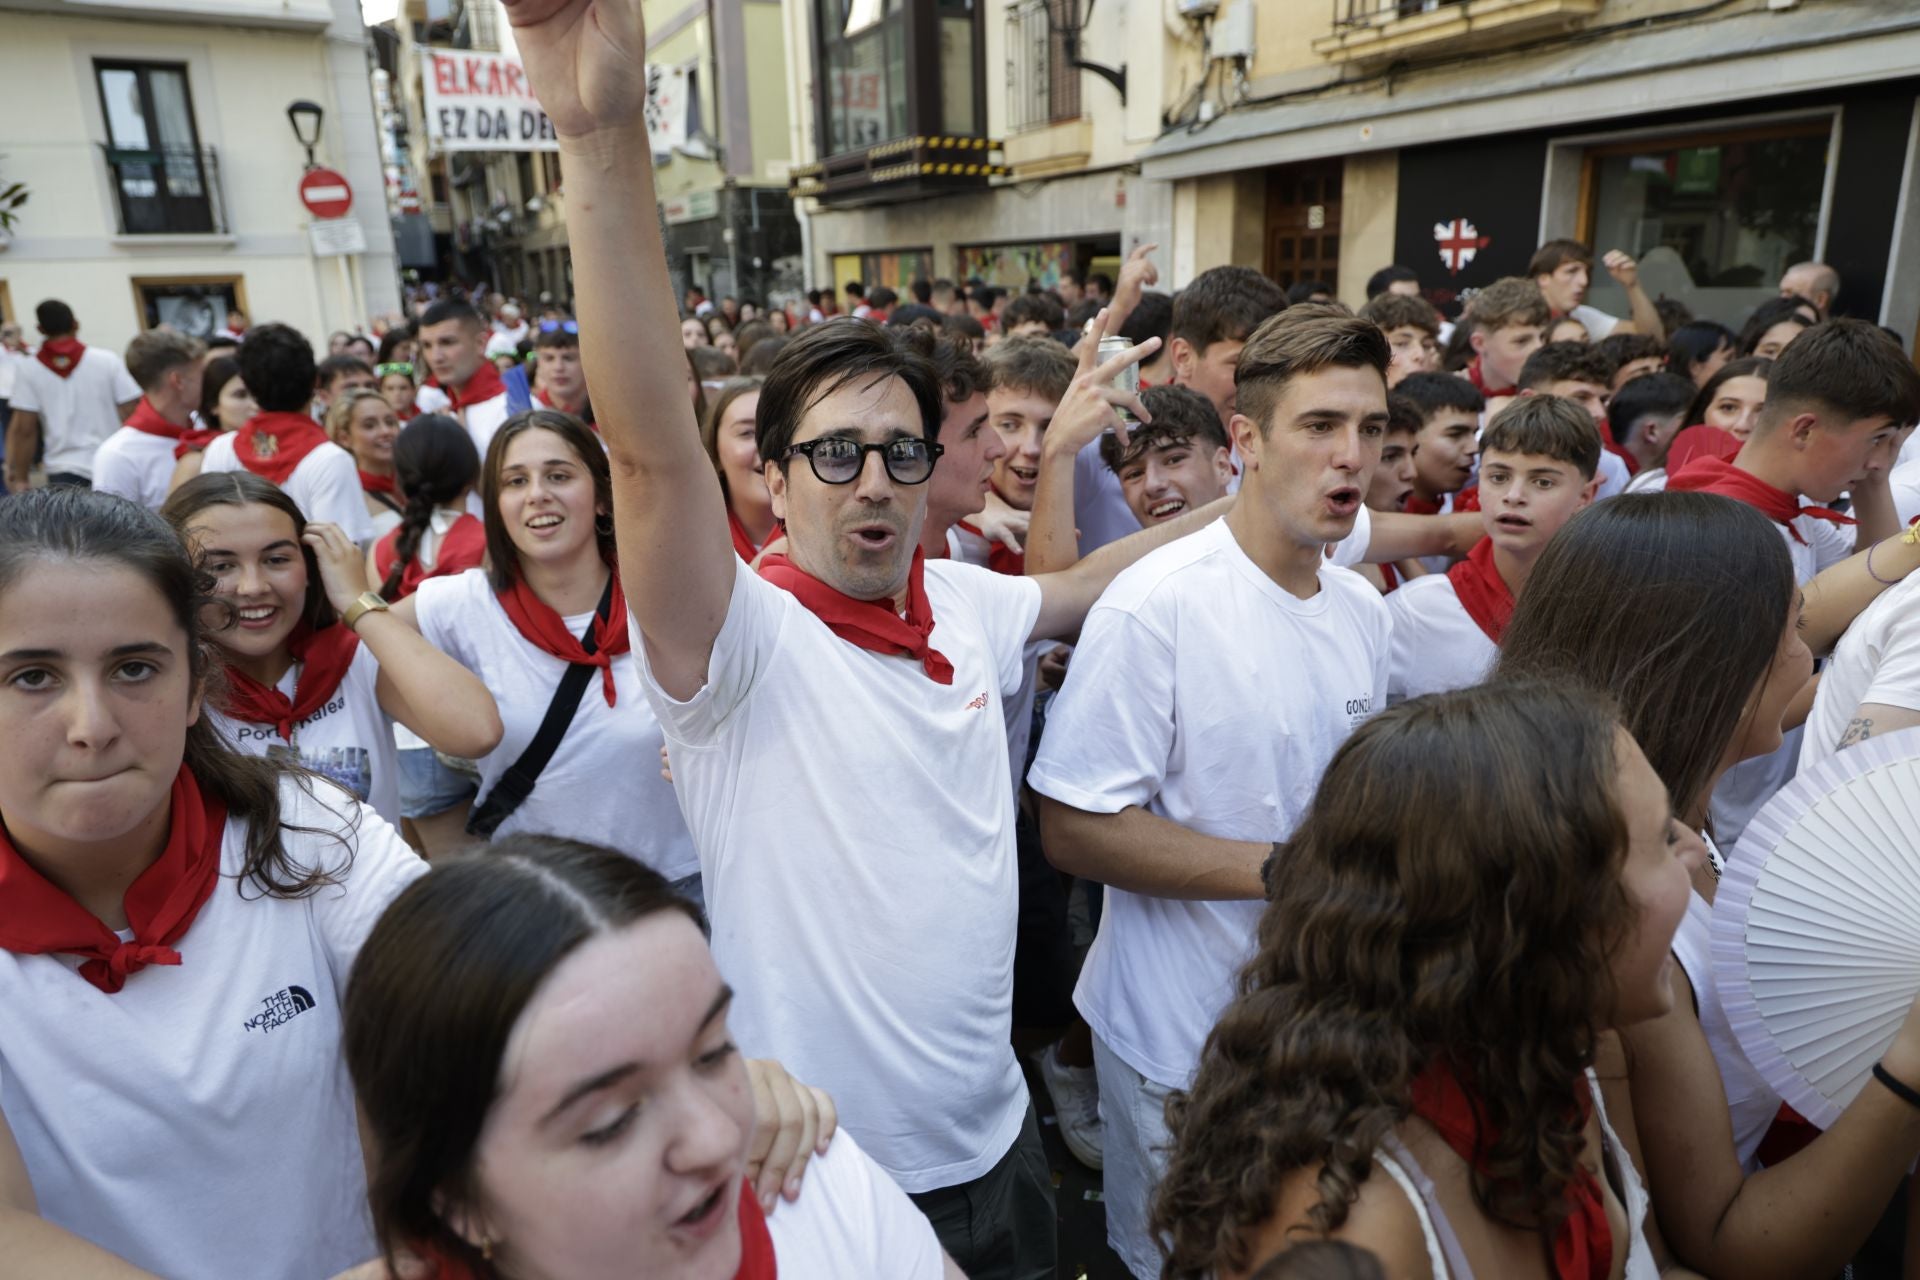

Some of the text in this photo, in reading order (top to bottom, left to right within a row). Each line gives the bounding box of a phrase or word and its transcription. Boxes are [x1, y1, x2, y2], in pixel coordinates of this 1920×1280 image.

[439, 106, 467, 139] EZ
[476, 107, 509, 140] DA
[238, 723, 283, 741] Port
[261, 988, 289, 1009] THE
[243, 996, 293, 1032] NORTH
[262, 1007, 296, 1034] FACE
